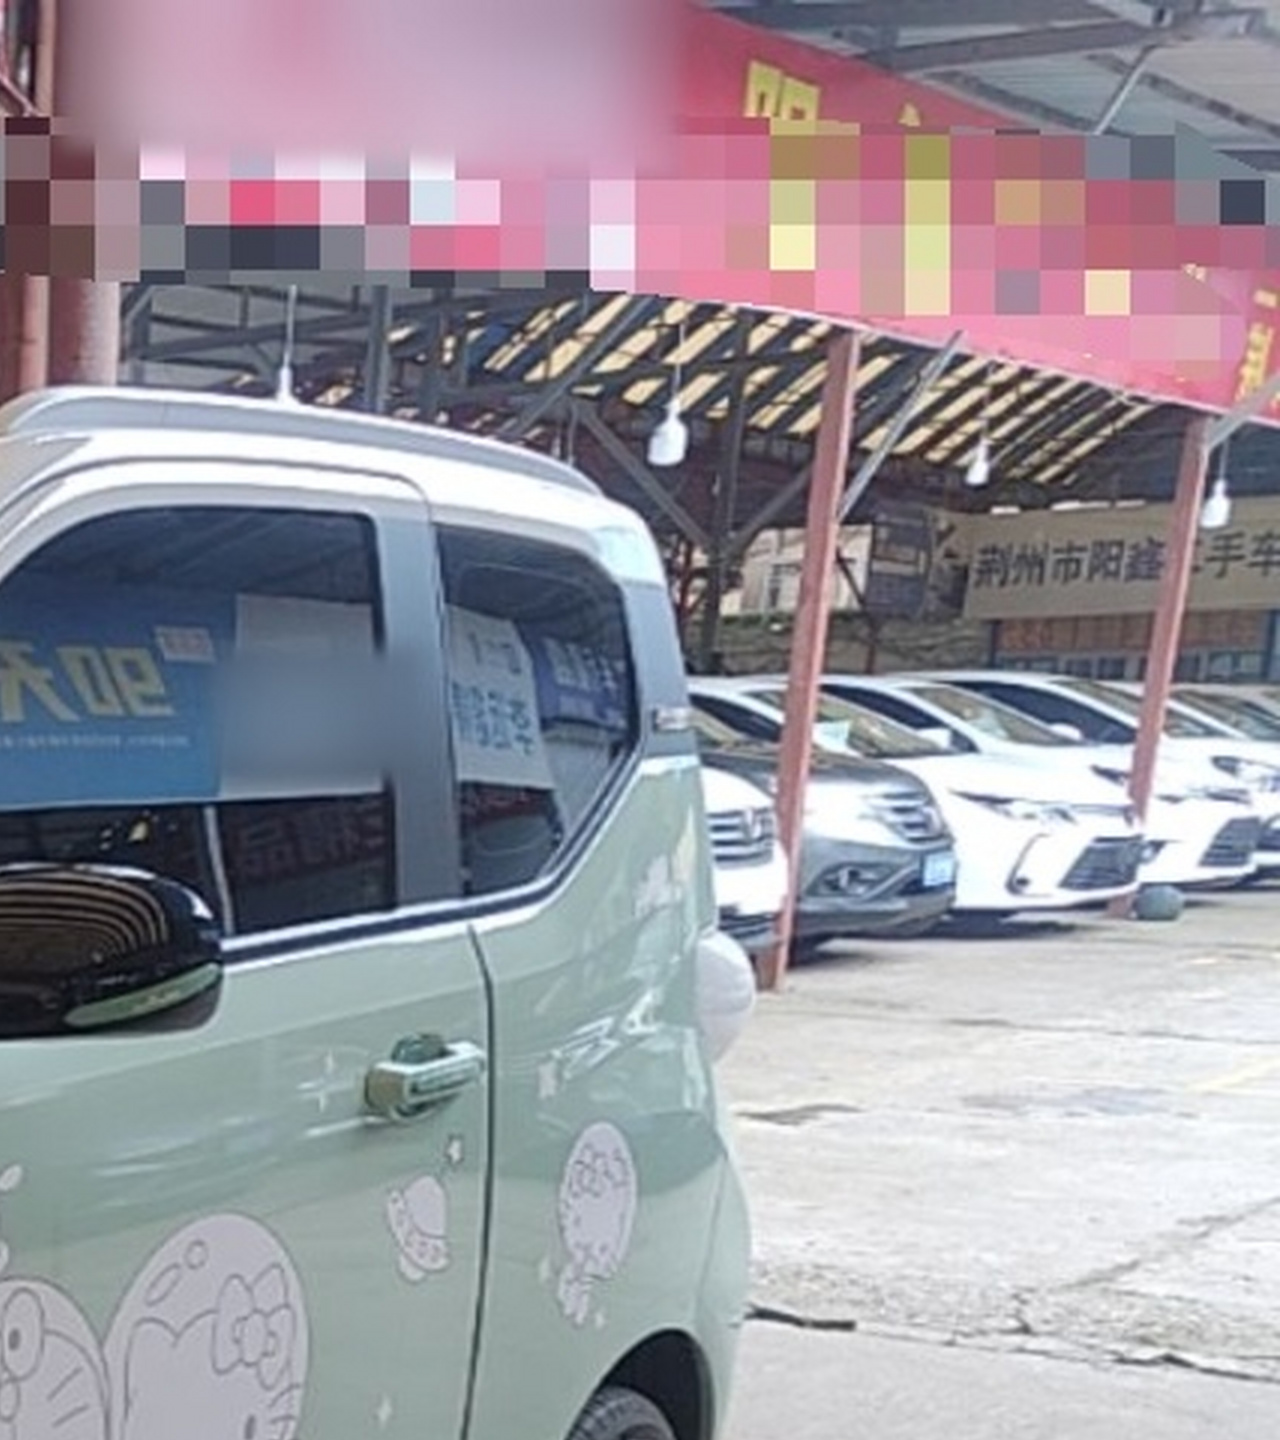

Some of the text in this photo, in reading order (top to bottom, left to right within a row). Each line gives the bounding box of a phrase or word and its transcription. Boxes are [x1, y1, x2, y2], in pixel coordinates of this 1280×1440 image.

[973, 531, 1280, 588] 荆州市阳鑫手车
